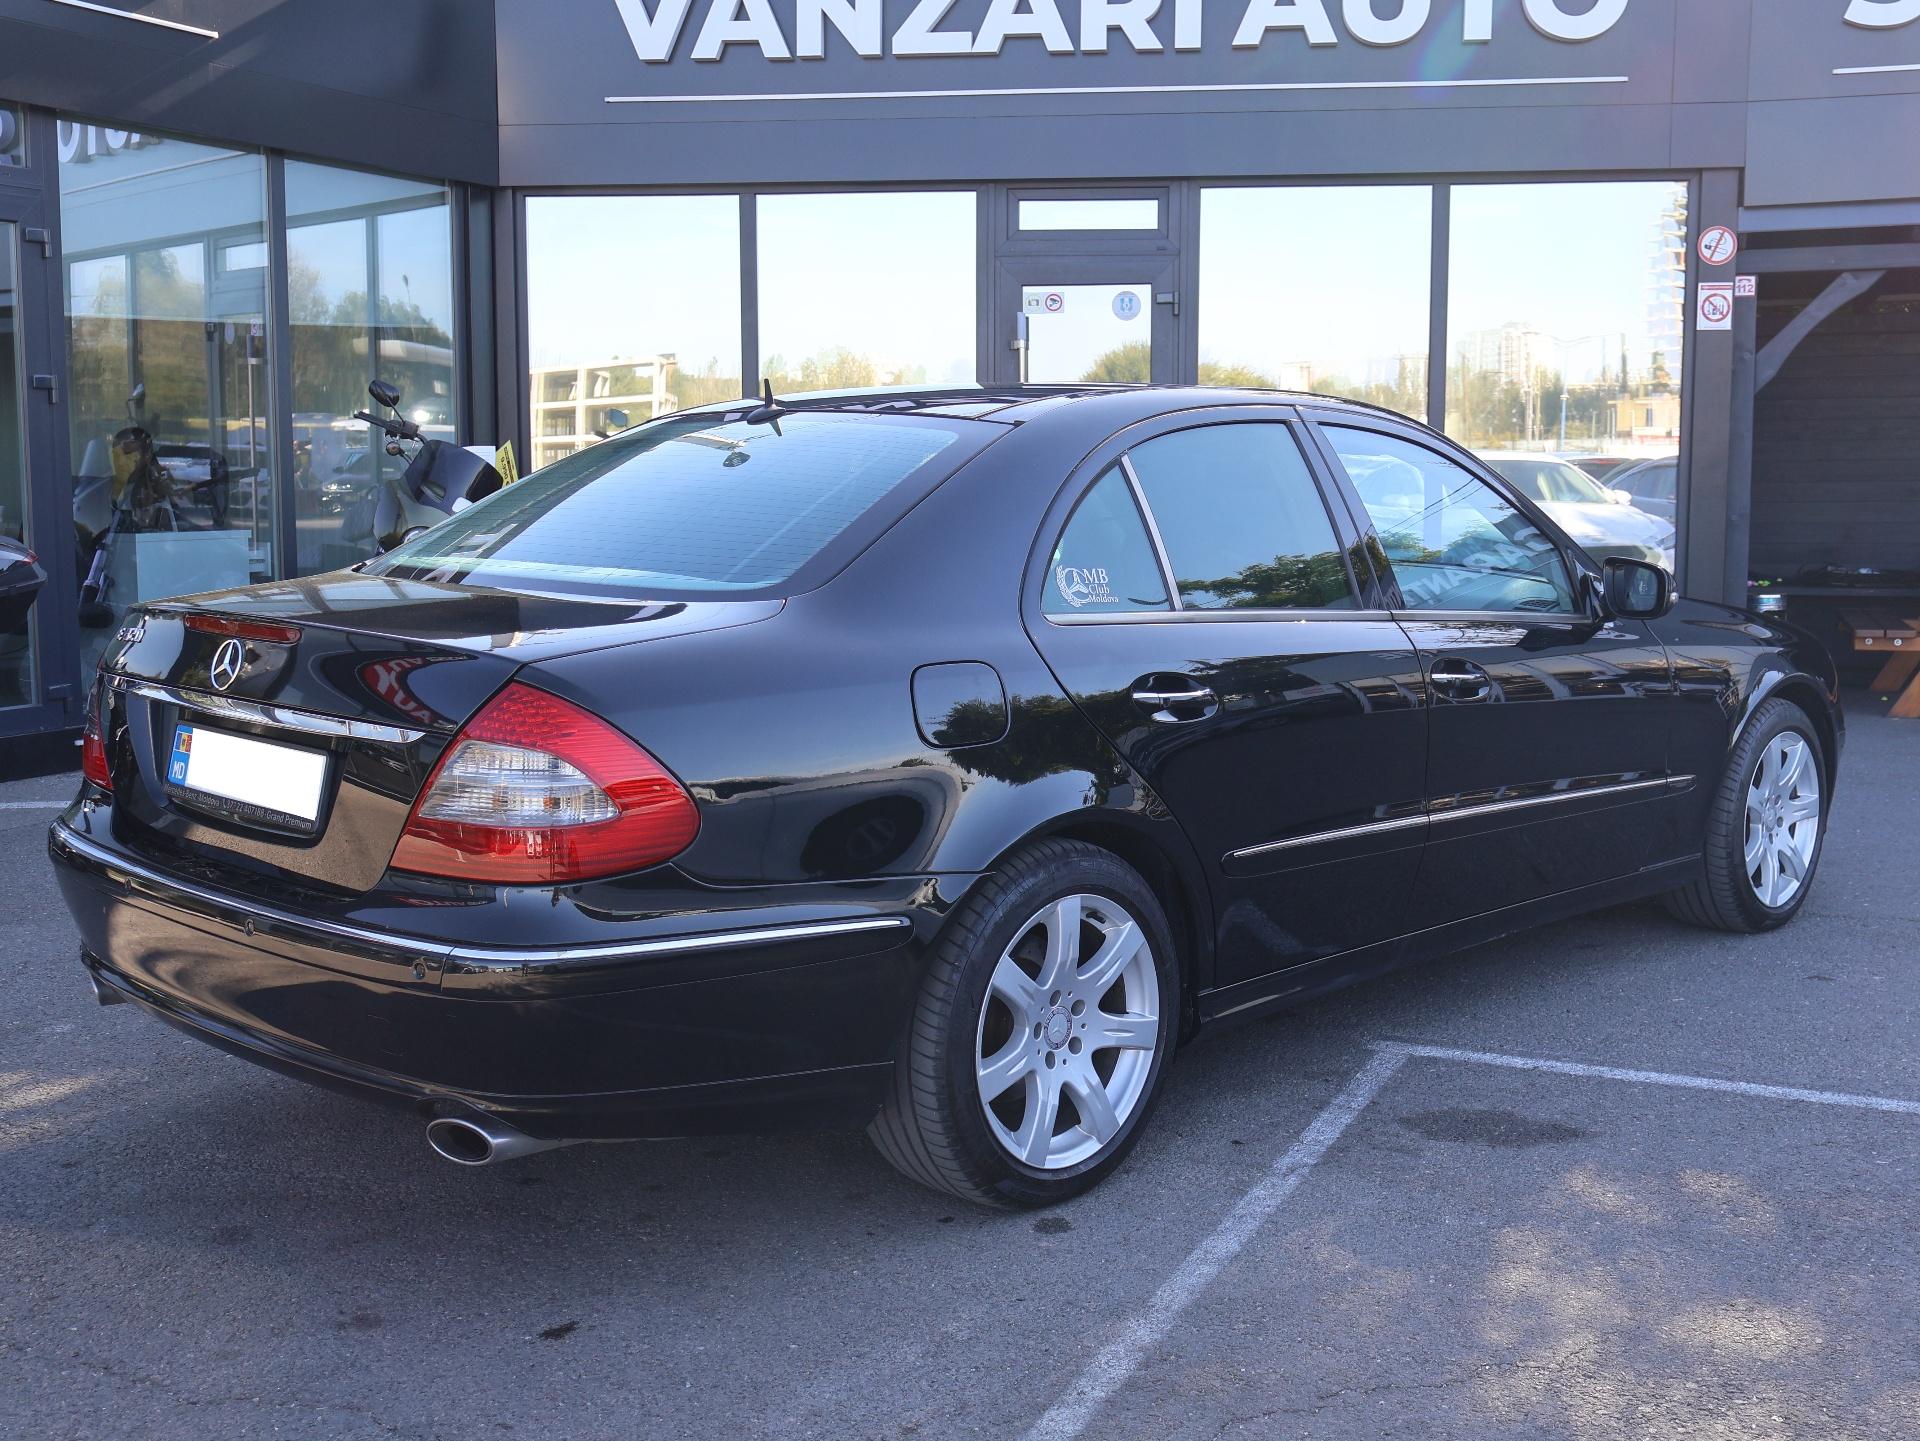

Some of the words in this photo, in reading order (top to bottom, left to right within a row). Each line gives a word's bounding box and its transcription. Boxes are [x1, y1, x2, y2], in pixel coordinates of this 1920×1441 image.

[1736, 284, 1754, 293] 112
[1082, 568, 1109, 584] MB
[1088, 584, 1110, 594] Club
[1088, 594, 1119, 603] Moldova
[172, 761, 186, 779] MD
[285, 814, 312, 830] Premium
